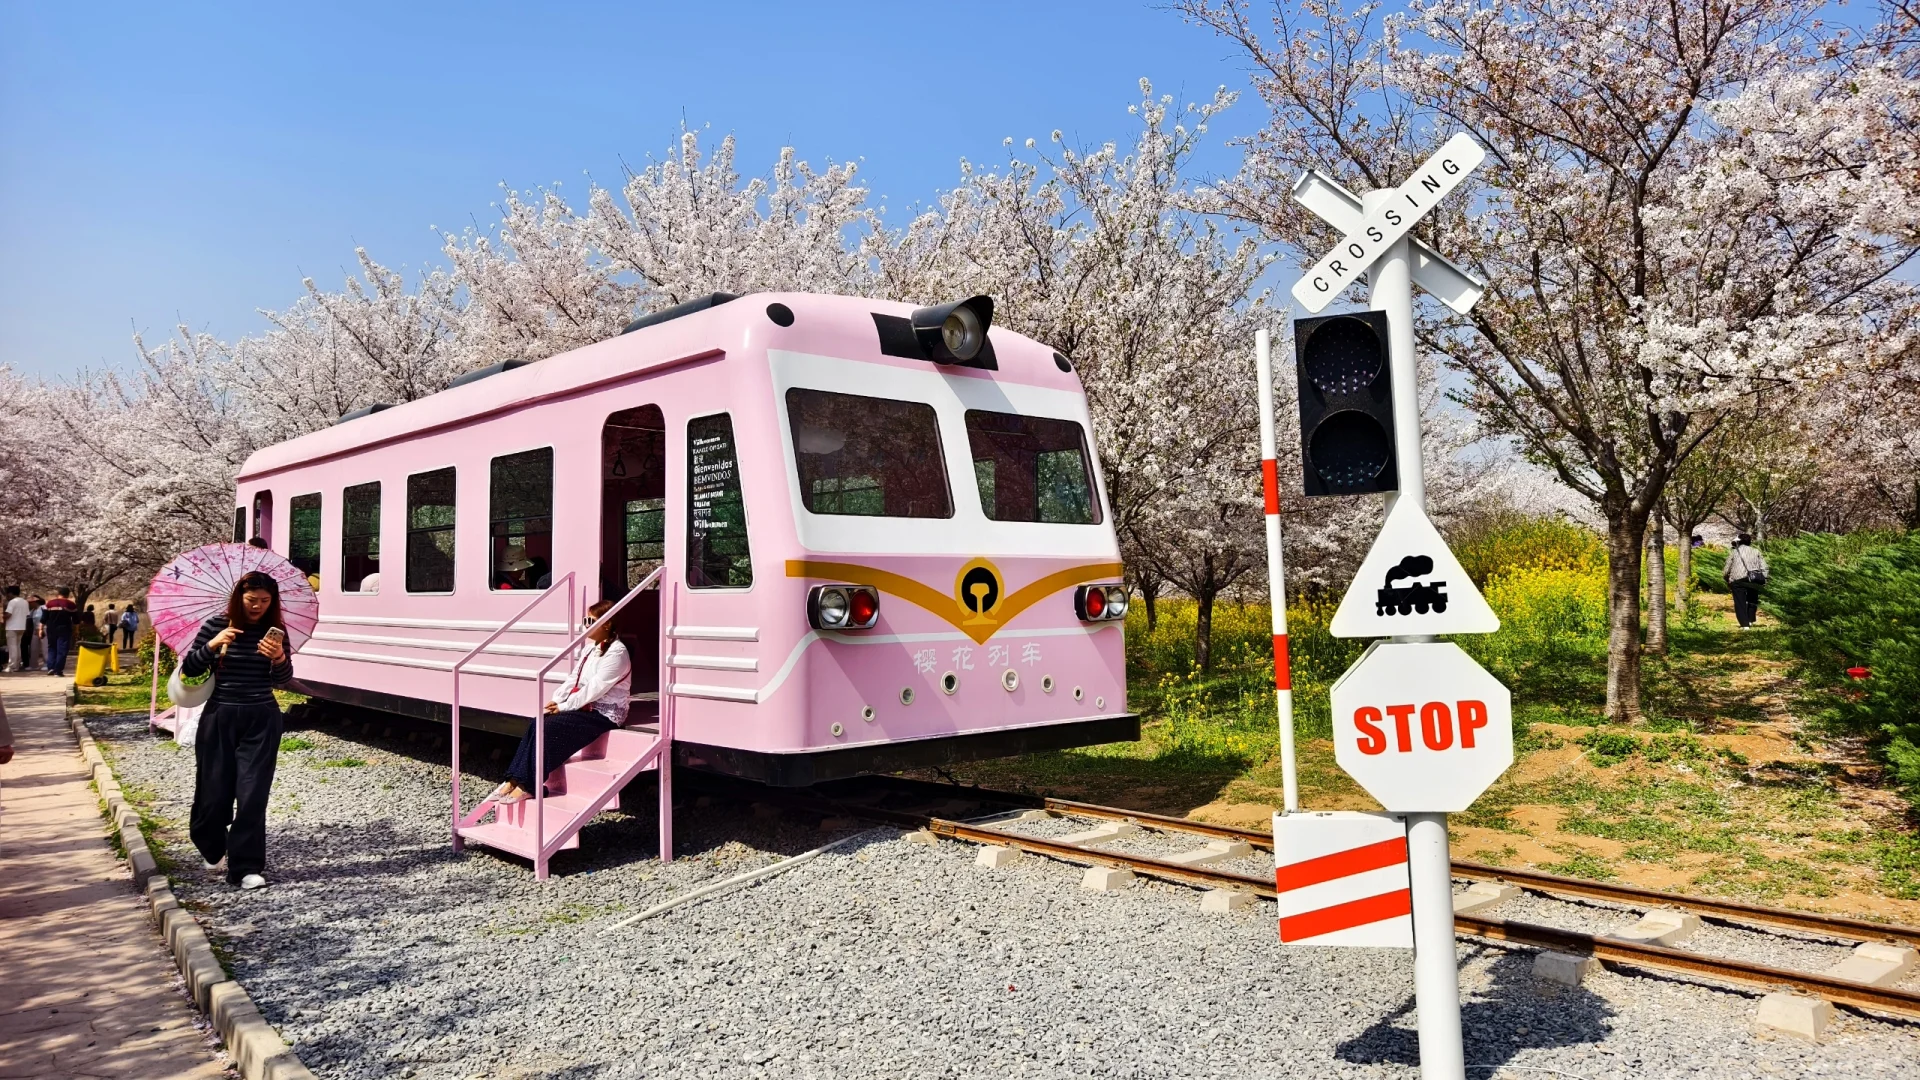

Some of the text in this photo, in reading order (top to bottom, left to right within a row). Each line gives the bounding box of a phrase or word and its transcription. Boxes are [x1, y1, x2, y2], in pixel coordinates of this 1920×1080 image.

[1313, 159, 1460, 292] CROSSING
[694, 460, 733, 474] Bienvenidos
[913, 641, 1042, 674] 樱花列车
[1353, 700, 1488, 755] STOP
